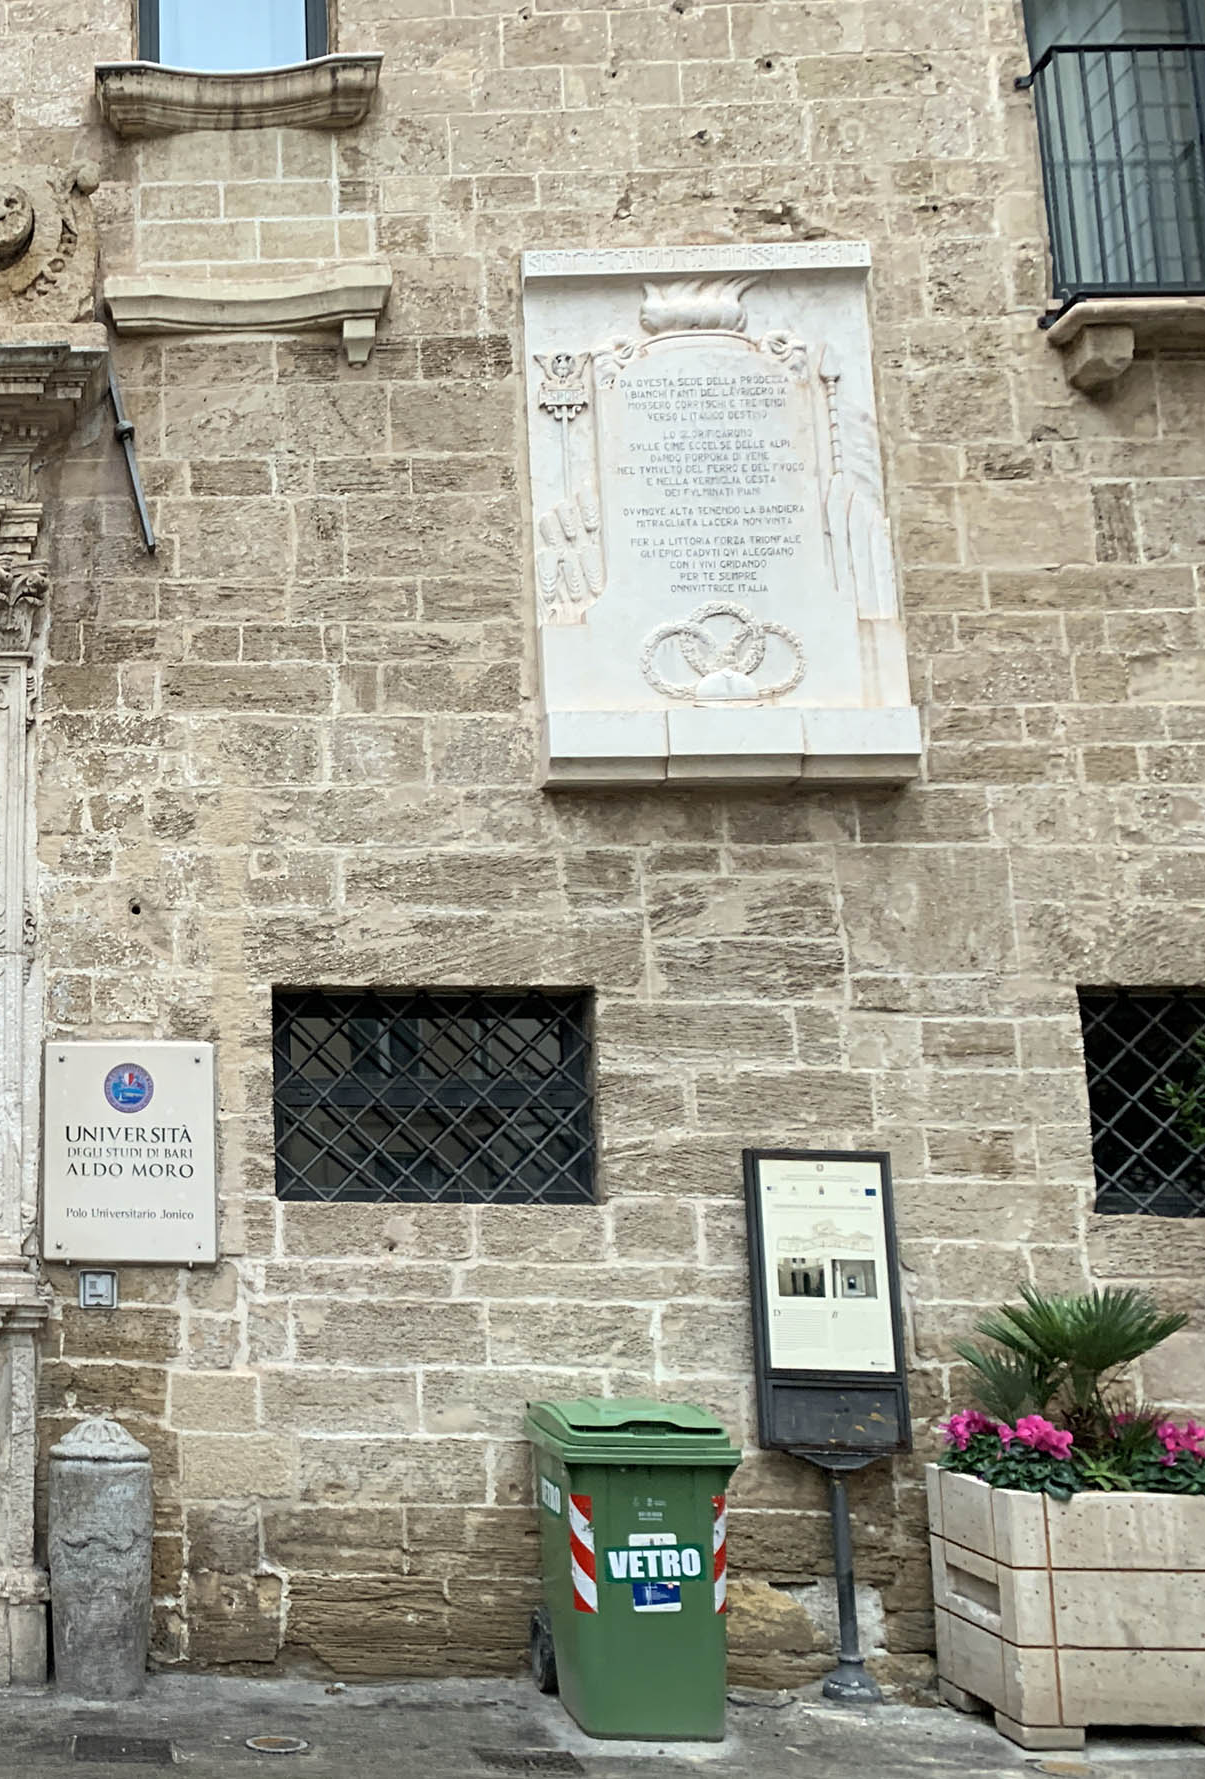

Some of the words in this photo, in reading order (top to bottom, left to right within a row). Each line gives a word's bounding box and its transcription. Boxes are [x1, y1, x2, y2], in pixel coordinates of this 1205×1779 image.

[620, 379, 632, 388] DA
[677, 377, 702, 386] SEDE
[706, 376, 736, 385] DELLA
[740, 375, 788, 384] PRODEZZA
[631, 389, 667, 399] BIANCHI
[670, 388, 697, 398] FANTI
[701, 388, 719, 397] DEL
[628, 401, 671, 410] MOSSERO
[647, 412, 677, 421] VERSO
[663, 431, 676, 440] LO
[664, 441, 684, 450] CIME
[688, 441, 732, 450] ECCELSE
[735, 440, 765, 449] DELLE
[770, 439, 790, 448] ALPI
[650, 453, 682, 463] DANDO
[732, 452, 742, 461] DI
[617, 466, 635, 475] NEL
[685, 464, 703, 474] DEL
[707, 464, 738, 473] FERRO
[751, 463, 770, 472] DEL
[656, 476, 688, 486] NELLA
[745, 474, 776, 484] GESTA
[665, 488, 680, 497] DEI
[670, 506, 693, 516] ALTA
[698, 506, 740, 515] TENENDO
[744, 505, 756, 514] LA
[759, 504, 805, 513] BANDIERA
[636, 518, 698, 528] MITRAGLIATA
[701, 518, 739, 527] LACERA
[742, 517, 761, 526] NON
[764, 516, 793, 525] VINTA
[630, 538, 648, 546] PER
[653, 537, 665, 546] LA
[668, 537, 711, 545] LITTORIA
[714, 536, 746, 545] FORZA
[750, 535, 802, 544] TRIONFALE
[640, 550, 655, 558] GLI
[659, 549, 682, 558] EPICI
[742, 547, 794, 557] ALEGGIANO
[669, 560, 689, 569] CON
[699, 560, 716, 568] VIVI
[719, 559, 767, 568] GRIDANDO
[680, 572, 697, 581] PER
[703, 572, 715, 581] TE
[718, 571, 757, 580] SEMPRE
[670, 584, 734, 592] ONNIVITTRICE
[738, 583, 769, 592] ITALIA
[65, 1124, 192, 1143] UNIVERSITÀ
[67, 1147, 102, 1158] DEGLI
[106, 1147, 142, 1158] STUDI
[146, 1147, 159, 1159] DI
[164, 1148, 193, 1159] BARI
[65, 1162, 123, 1177] ALDO
[131, 1163, 194, 1178] MORO
[66, 1207, 88, 1218] Polo
[91, 1207, 157, 1219] Universitario
[160, 1209, 194, 1220] Jonico
[607, 1548, 701, 1578] VETRO
